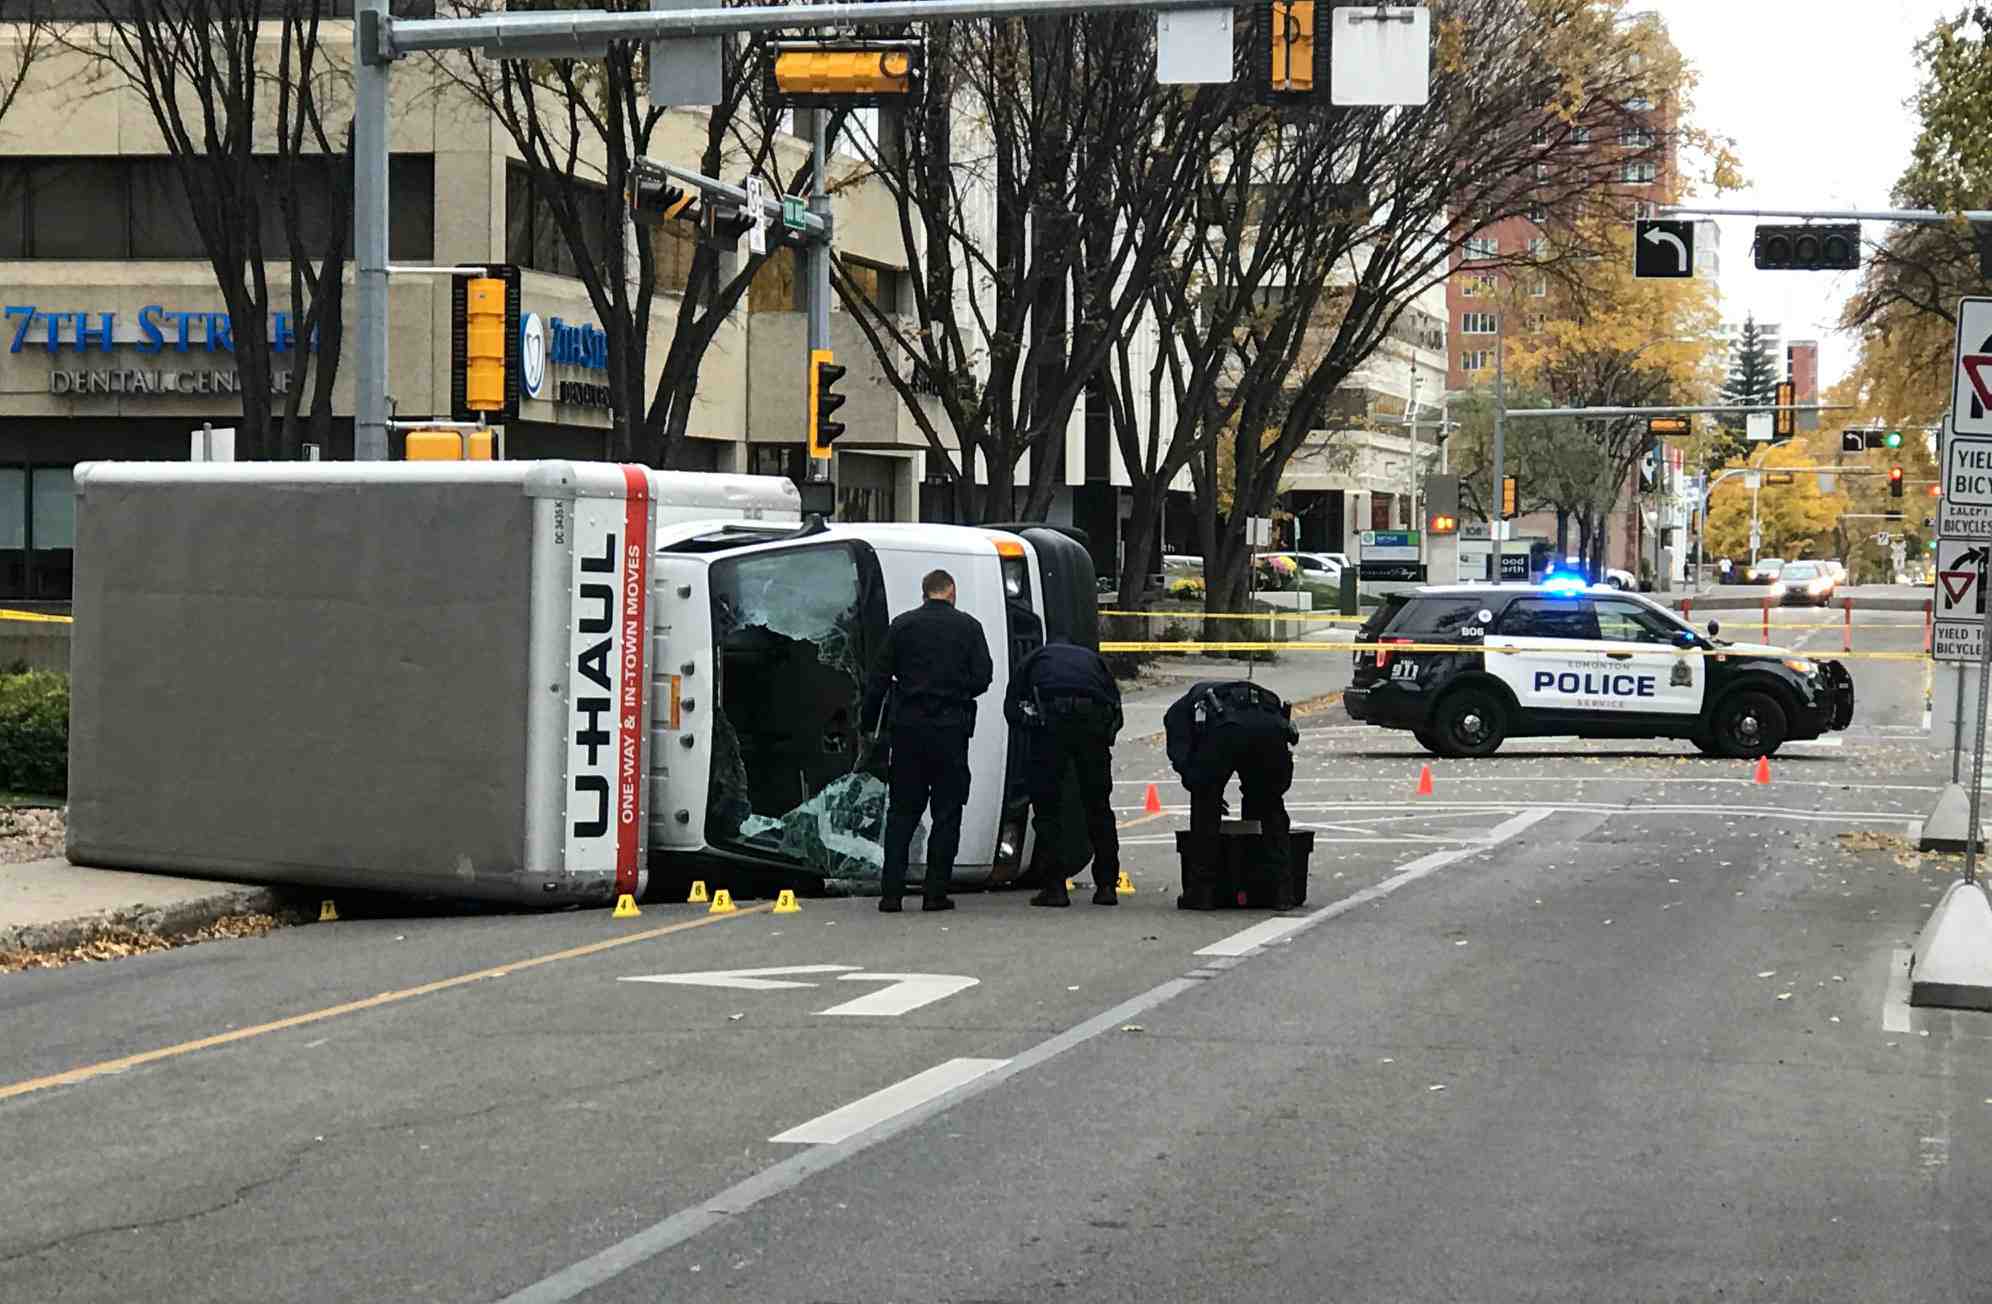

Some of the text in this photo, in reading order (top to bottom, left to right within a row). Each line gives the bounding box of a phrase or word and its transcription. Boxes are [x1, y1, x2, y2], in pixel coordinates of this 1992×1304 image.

[5, 306, 116, 353] 7TH
[50, 370, 166, 393] DENTAL
[1958, 449, 1992, 470] YIEL
[1502, 556, 1524, 566] ood
[1502, 566, 1524, 574] arth
[1937, 628, 1969, 640] YIELD
[1936, 642, 1984, 656] BICYCLE
[573, 533, 616, 838] U-HAUL
[621, 544, 641, 825] ONE-WAY & IN-TOWN MOVES
[1533, 671, 1656, 698] POLICE
